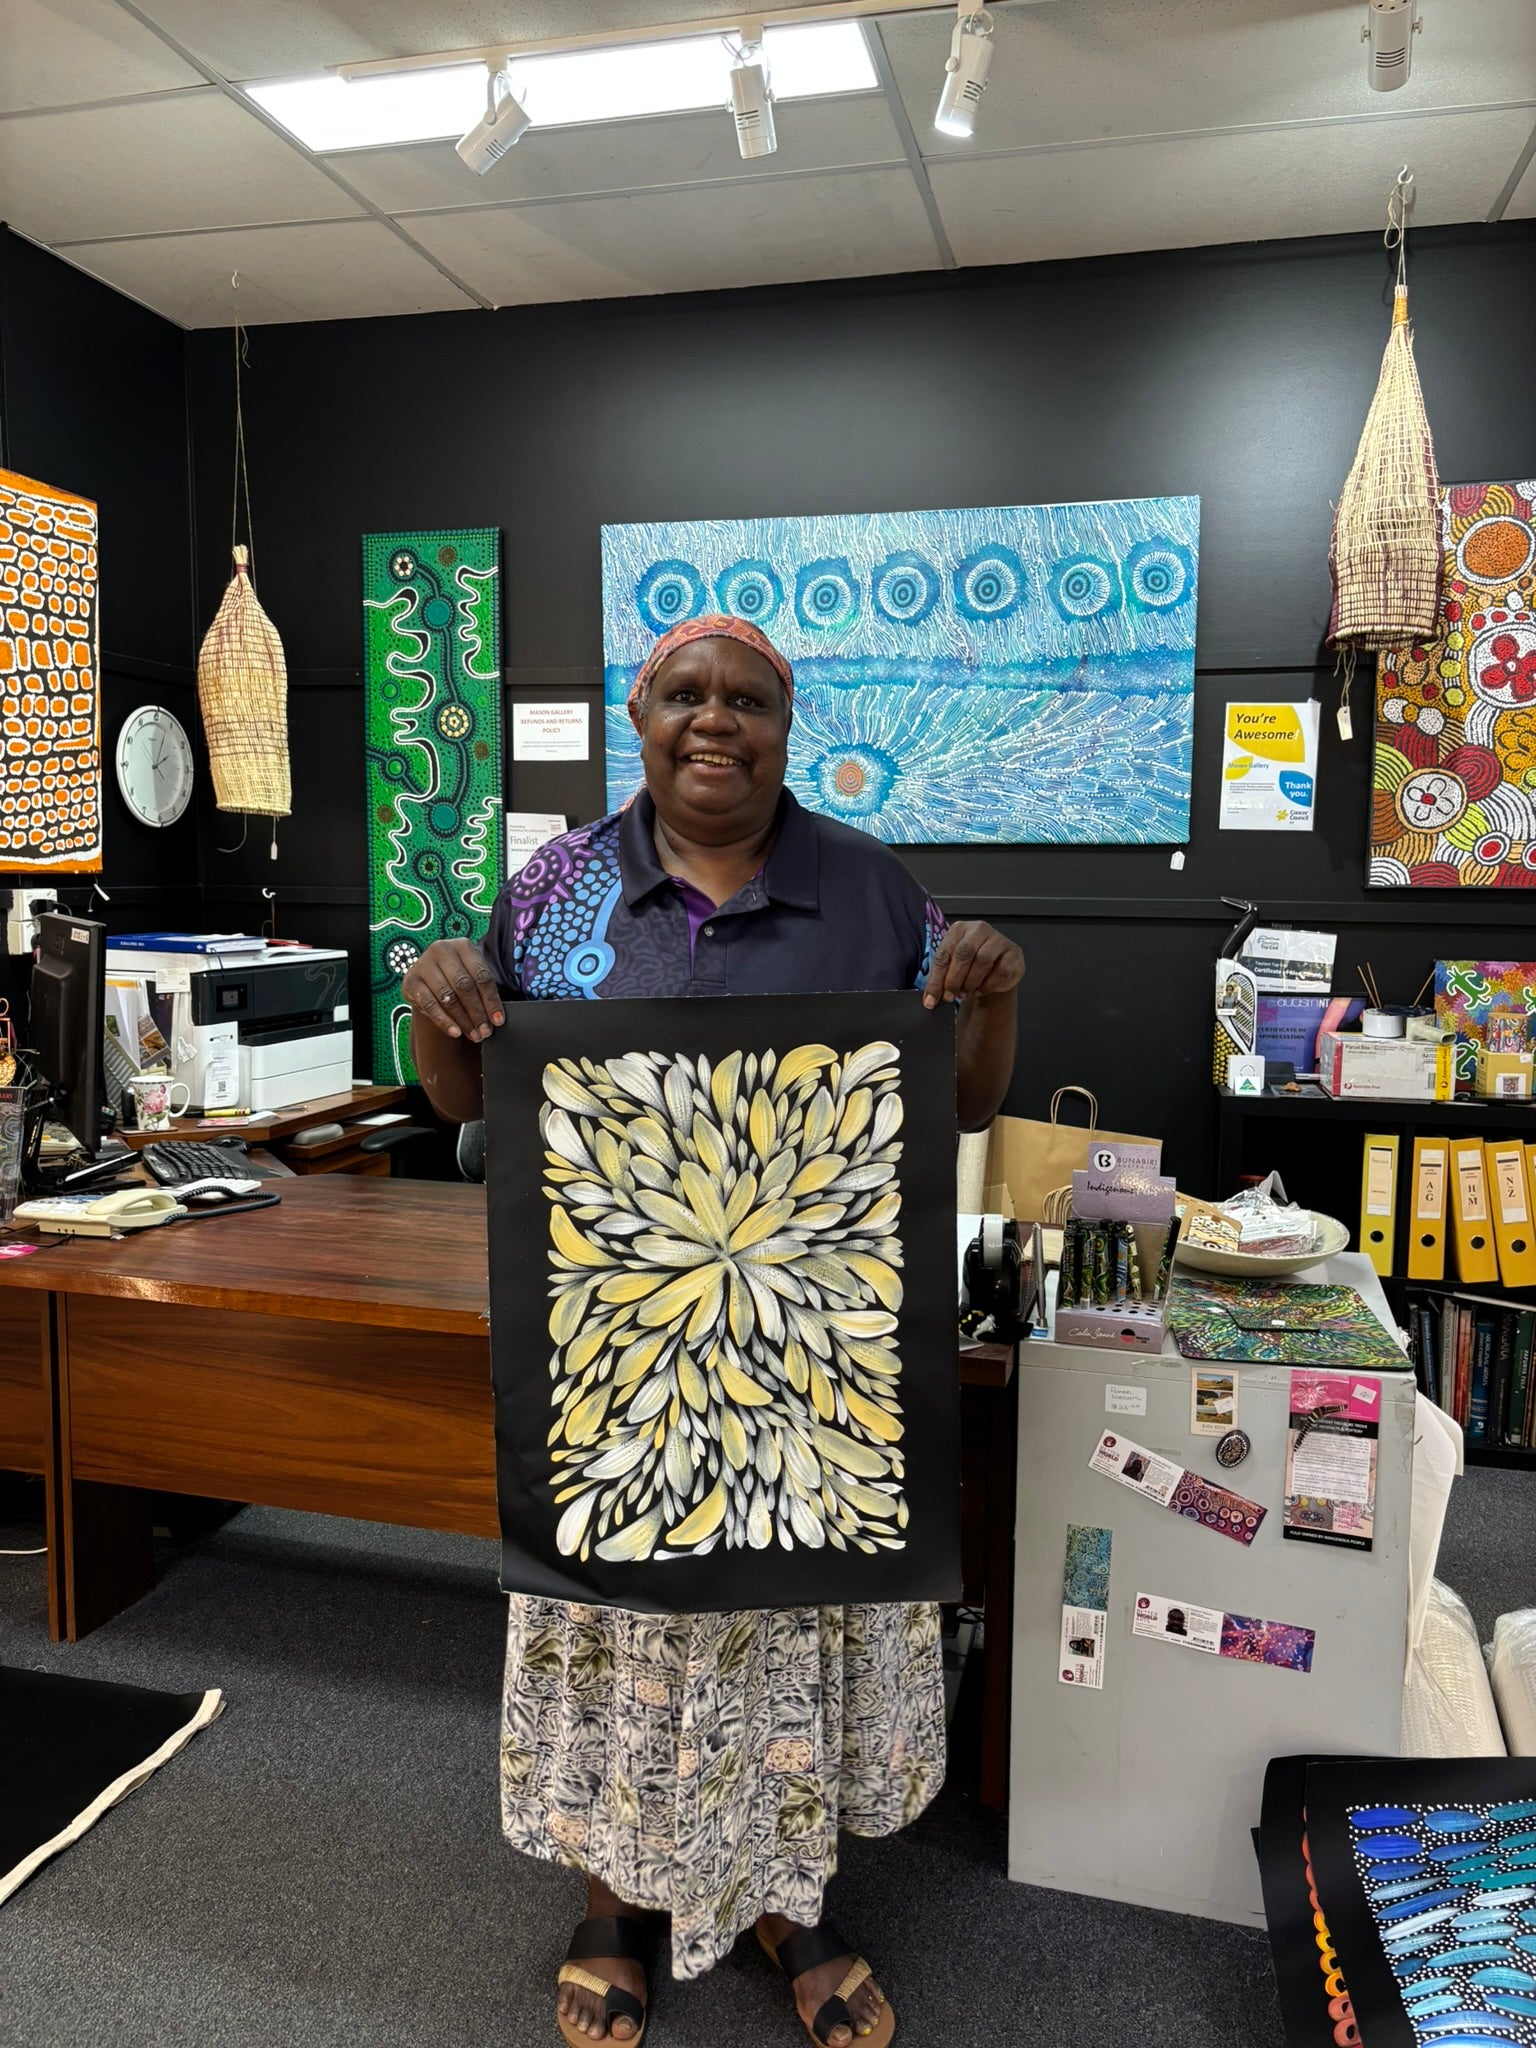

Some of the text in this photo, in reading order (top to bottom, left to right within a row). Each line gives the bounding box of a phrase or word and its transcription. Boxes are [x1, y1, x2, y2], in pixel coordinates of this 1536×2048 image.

[1234, 728, 1300, 740] Awesome!
[1285, 781, 1312, 790] Thank
[510, 836, 539, 845] Finalist
[1254, 967, 1282, 975] Certificate
[1117, 1157, 1158, 1166] BUNABIRI
[1506, 1176, 1514, 1185] N
[1426, 1181, 1435, 1190] A
[1467, 1184, 1476, 1193] H
[1425, 1193, 1434, 1202] G
[1508, 1189, 1516, 1198] Z
[1467, 1197, 1478, 1206] M
[1137, 1613, 1158, 1621] WORLD
